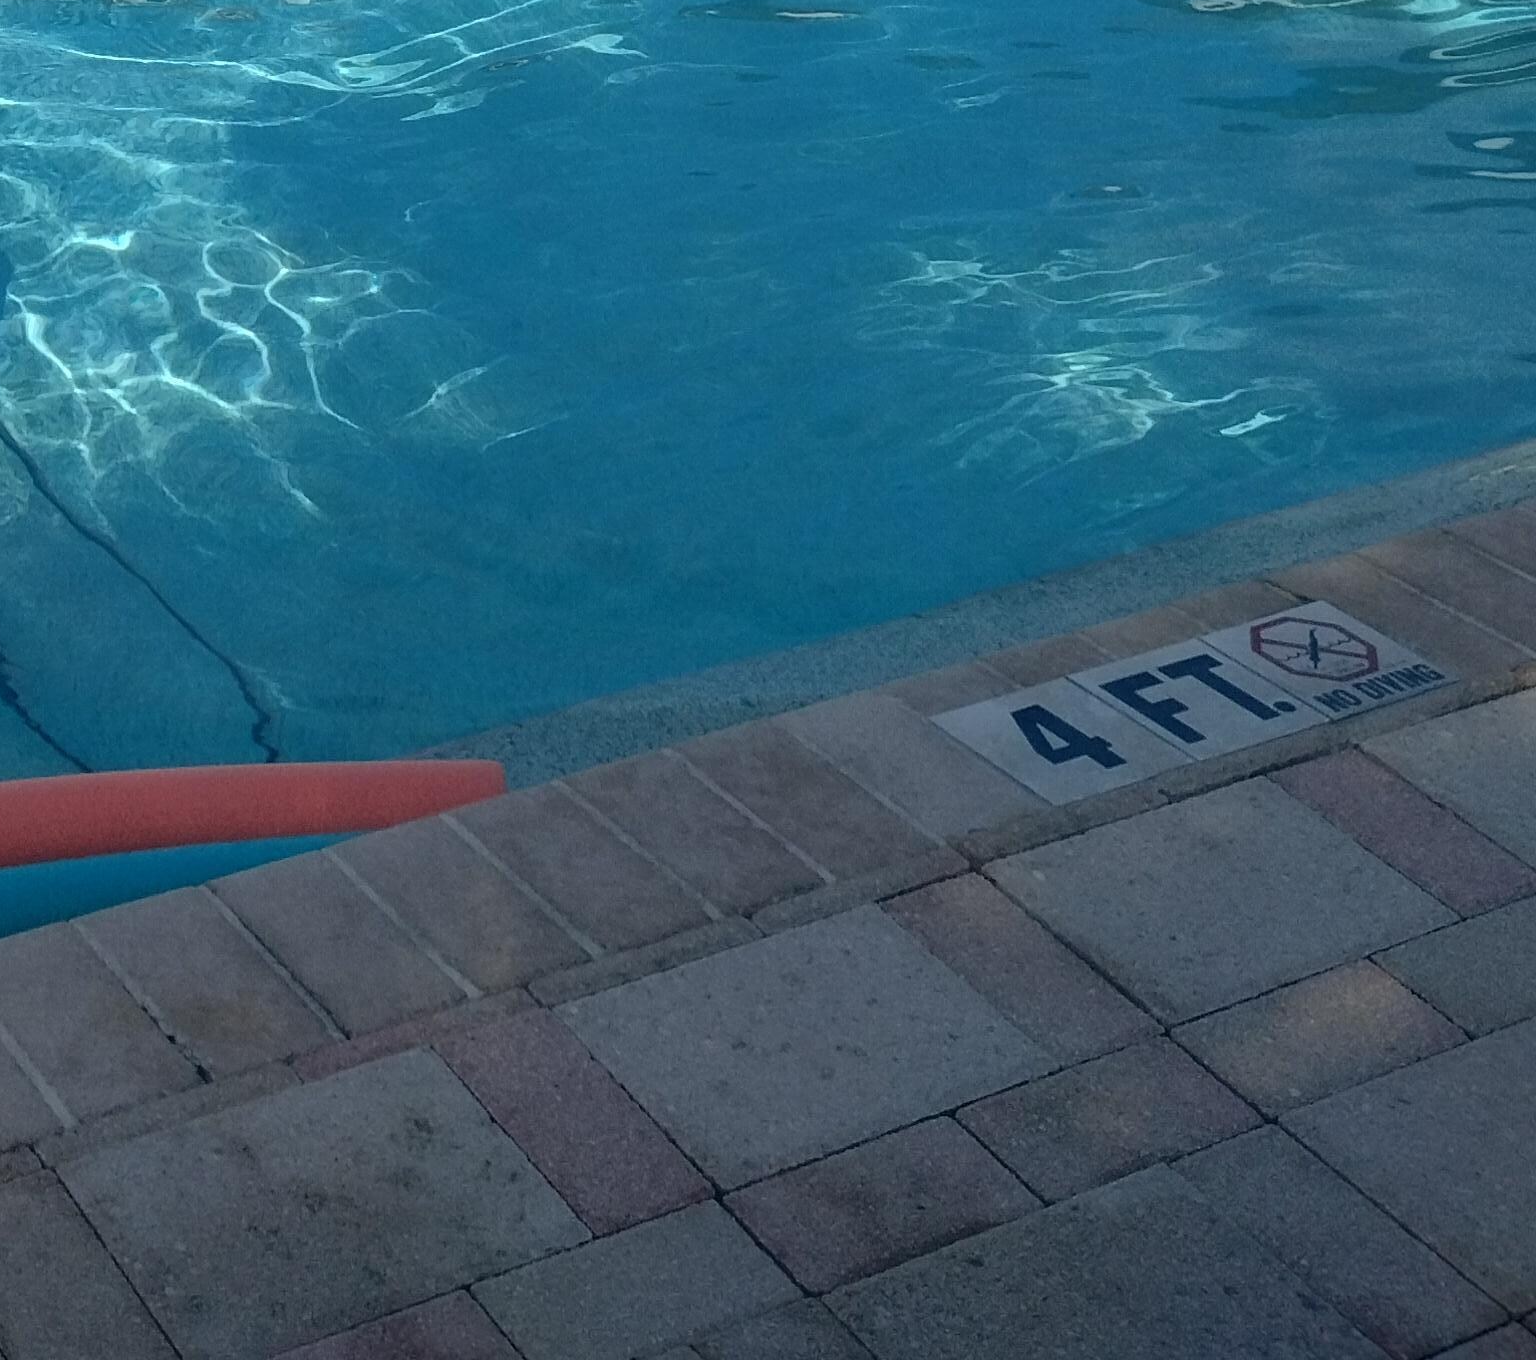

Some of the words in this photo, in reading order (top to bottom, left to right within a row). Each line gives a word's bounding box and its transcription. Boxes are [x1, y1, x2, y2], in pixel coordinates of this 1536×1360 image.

[1313, 689, 1363, 713] NO
[1352, 663, 1446, 700] DIVING
[1009, 703, 1127, 768] 4
